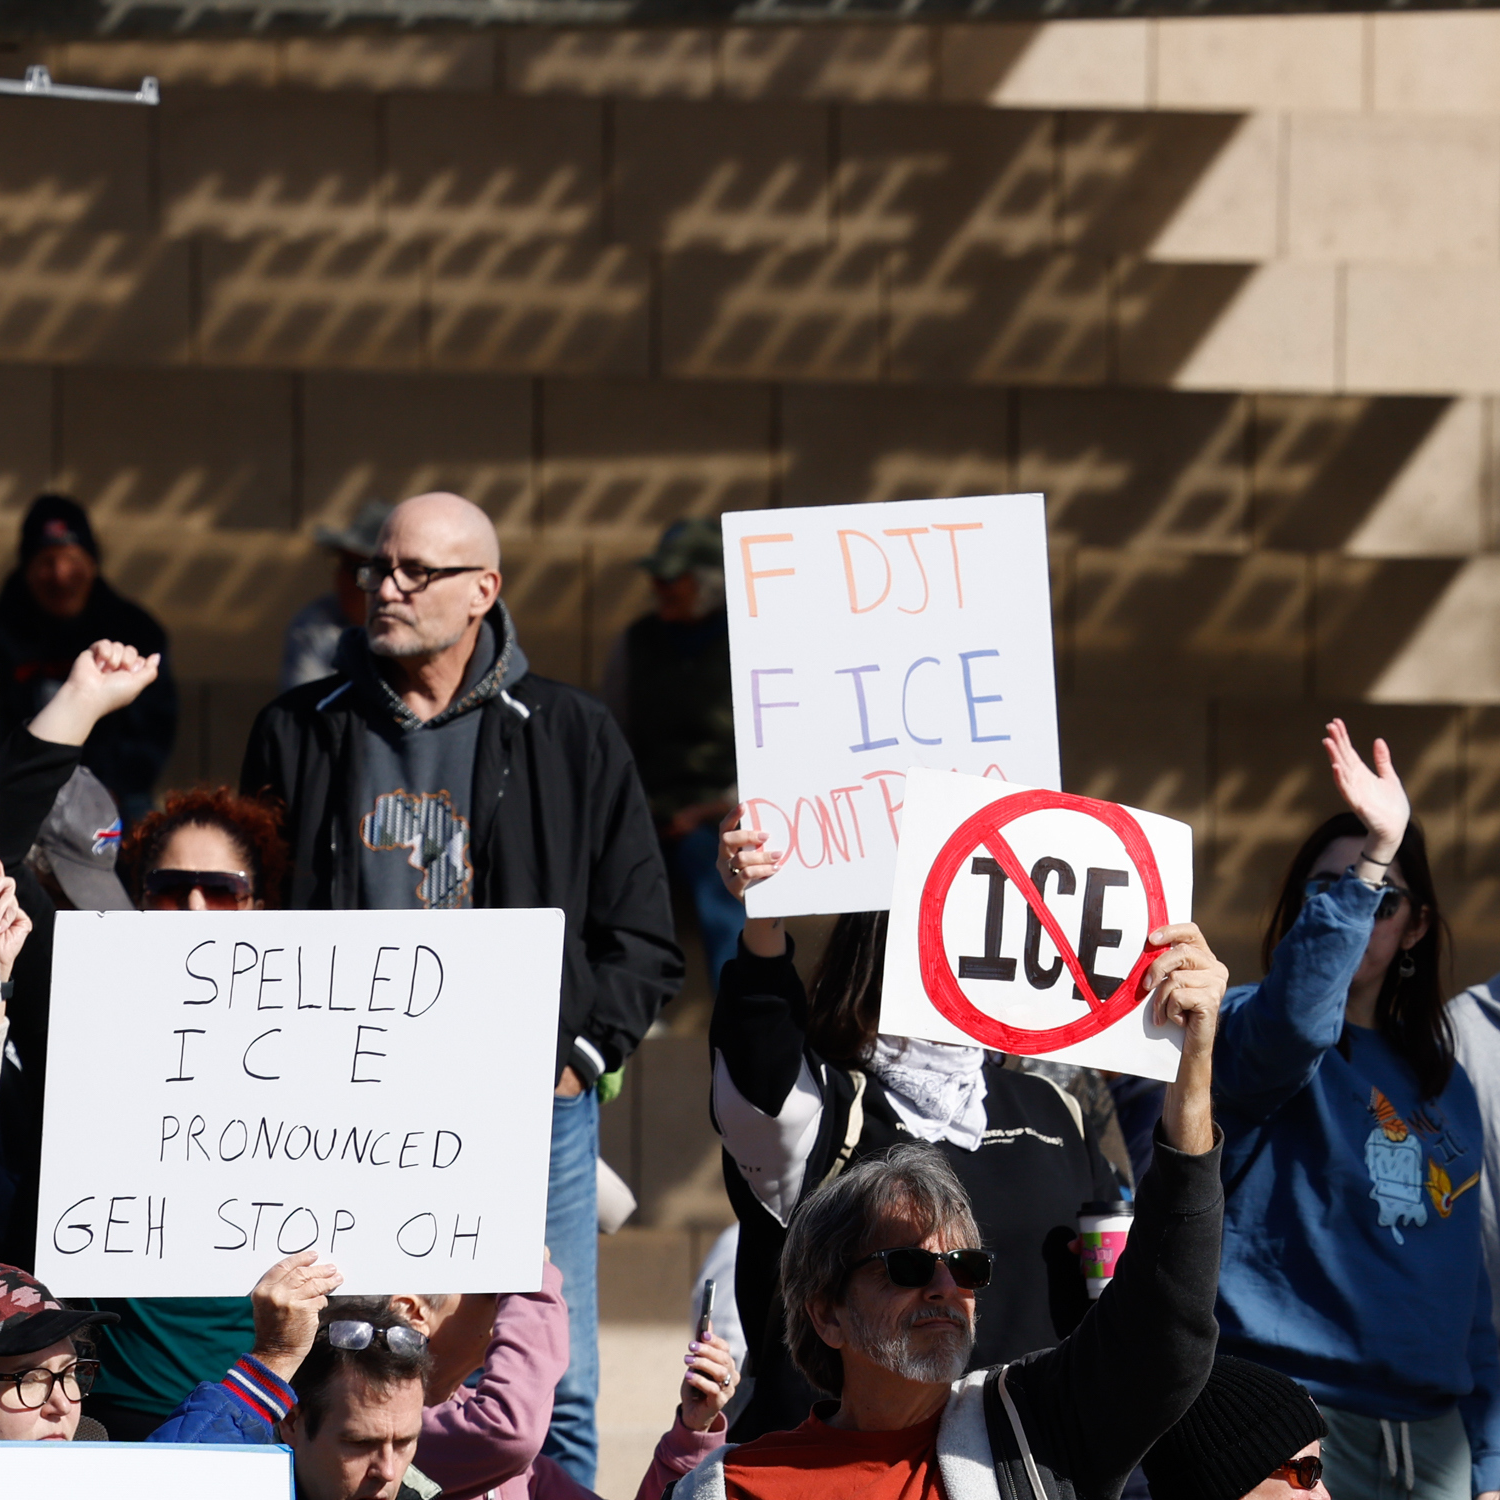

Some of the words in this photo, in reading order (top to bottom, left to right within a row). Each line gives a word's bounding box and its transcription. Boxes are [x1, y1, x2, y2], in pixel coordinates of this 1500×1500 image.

[740, 533, 795, 618] F
[837, 522, 983, 614] DJT
[750, 668, 799, 748] F
[835, 649, 1011, 753] ICE
[958, 856, 1129, 1002] ICE
[183, 940, 444, 1018] SPELLED
[160, 1114, 463, 1169] PRONOUNCED
[54, 1196, 166, 1259] GEH
[214, 1199, 356, 1256] STOP
[397, 1212, 482, 1260] OH
